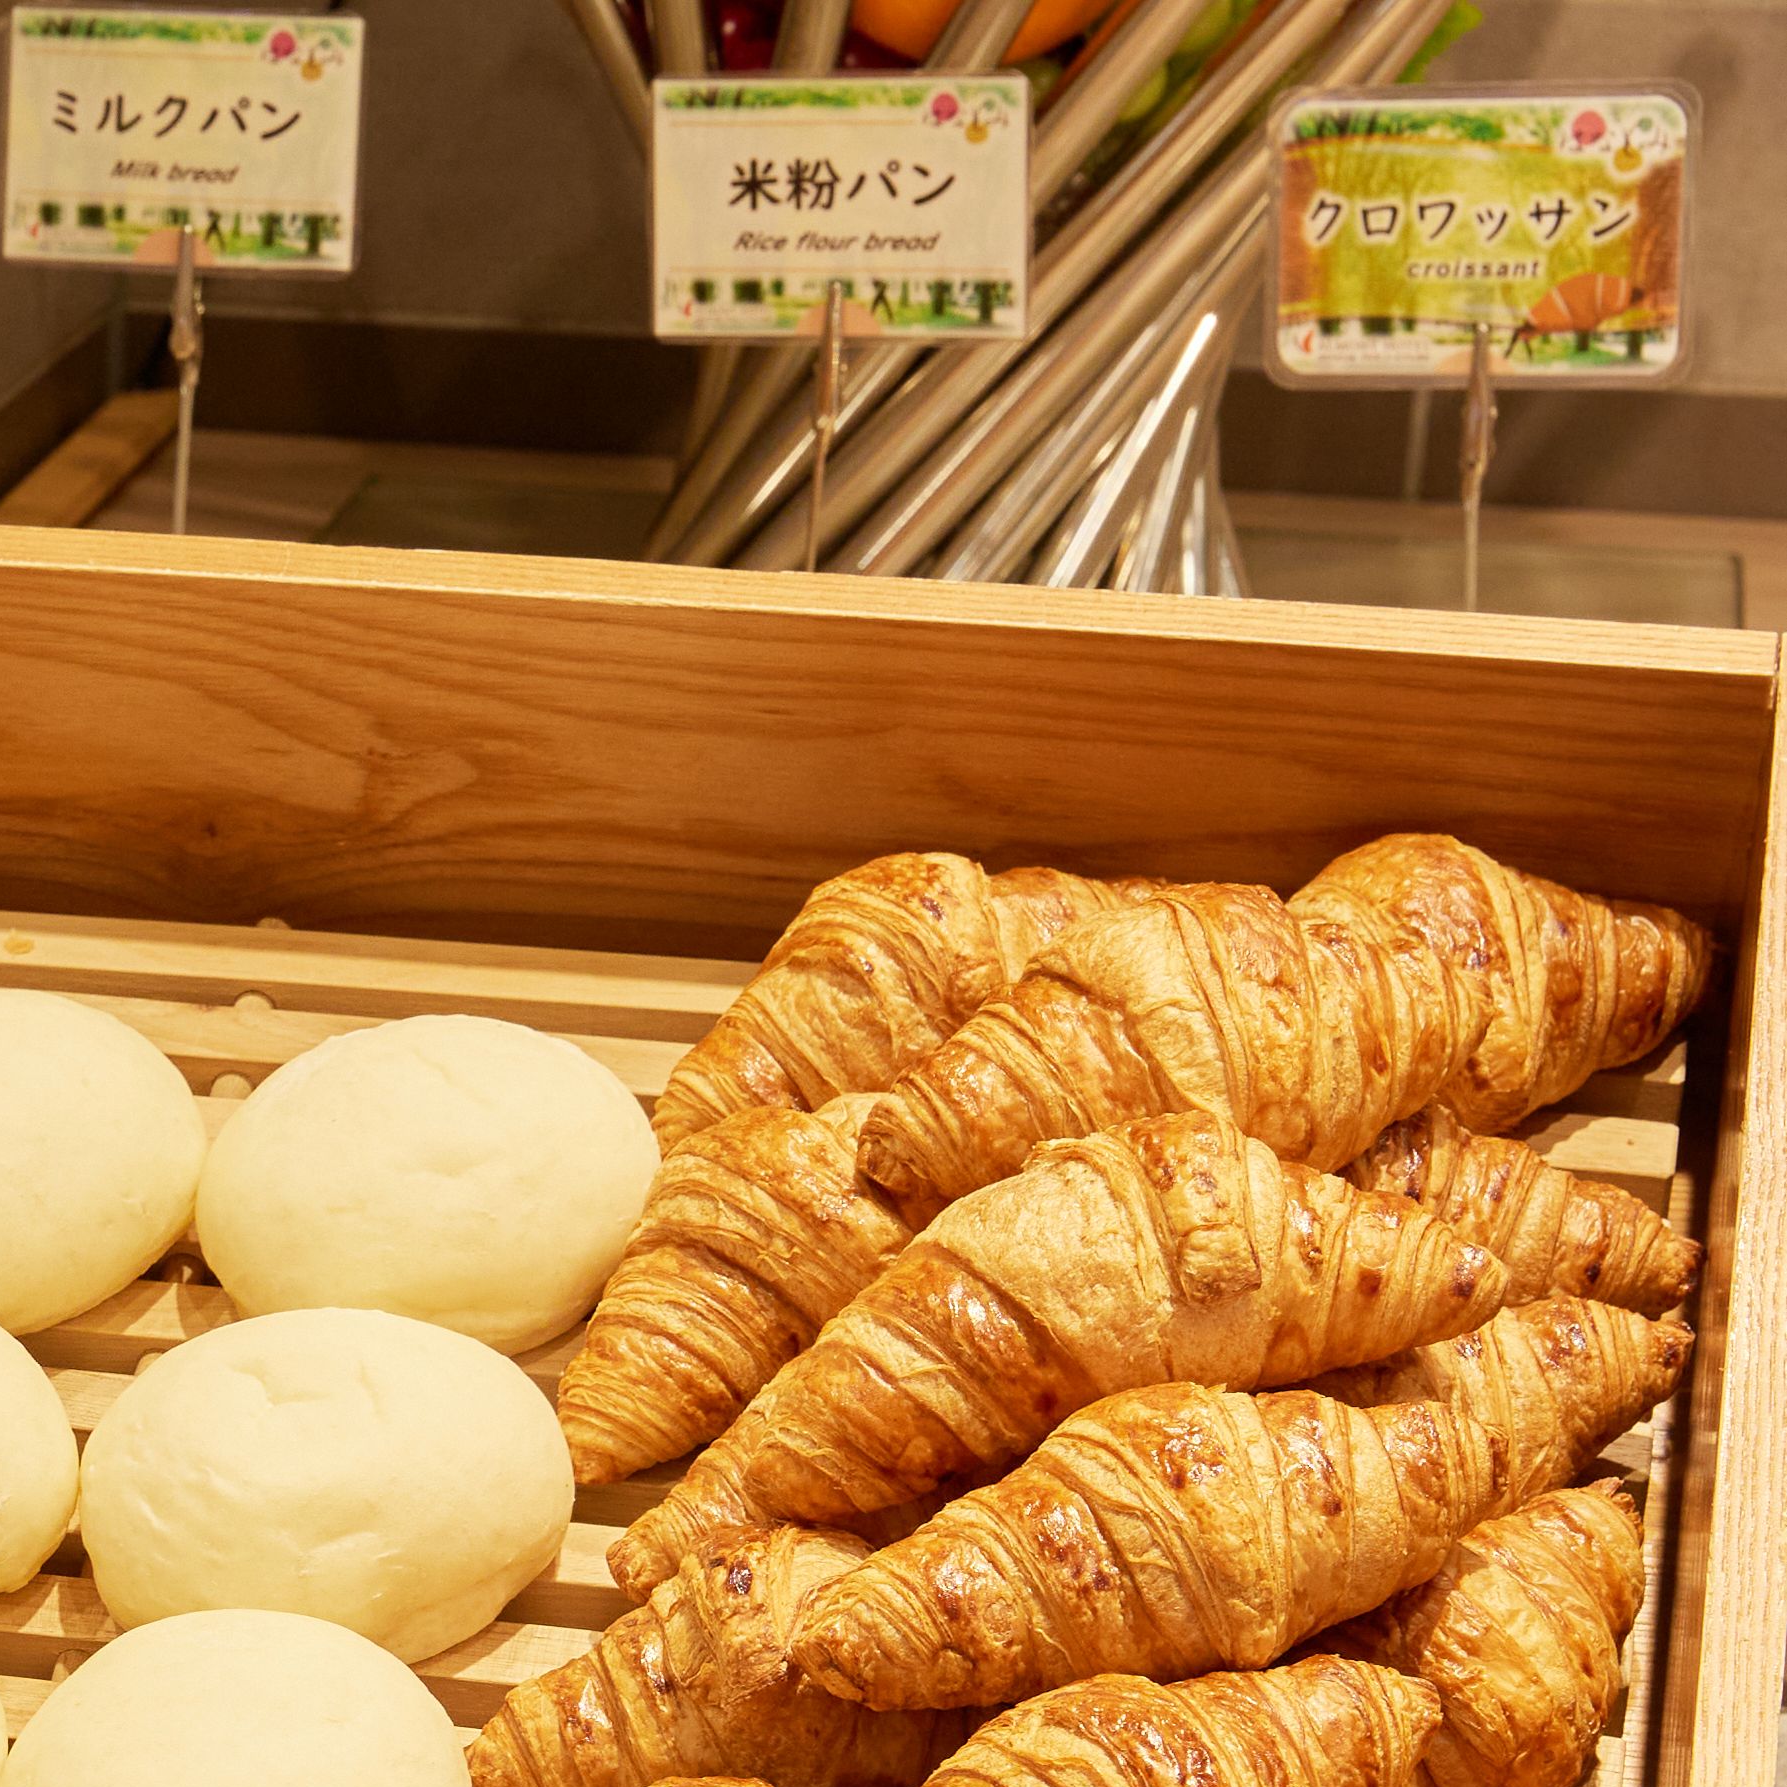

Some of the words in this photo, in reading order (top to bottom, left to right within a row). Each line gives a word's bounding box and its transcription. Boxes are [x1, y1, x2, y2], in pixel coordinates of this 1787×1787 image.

[53, 91, 302, 141] ミルクパン
[111, 159, 160, 180] Milk
[167, 163, 240, 185] bread
[729, 158, 956, 211] 米粉パン
[1309, 198, 1633, 242] クロワッサン
[733, 231, 788, 252] Rice
[796, 231, 858, 252] flour
[864, 232, 941, 252] bread
[1407, 258, 1542, 279] croissant
